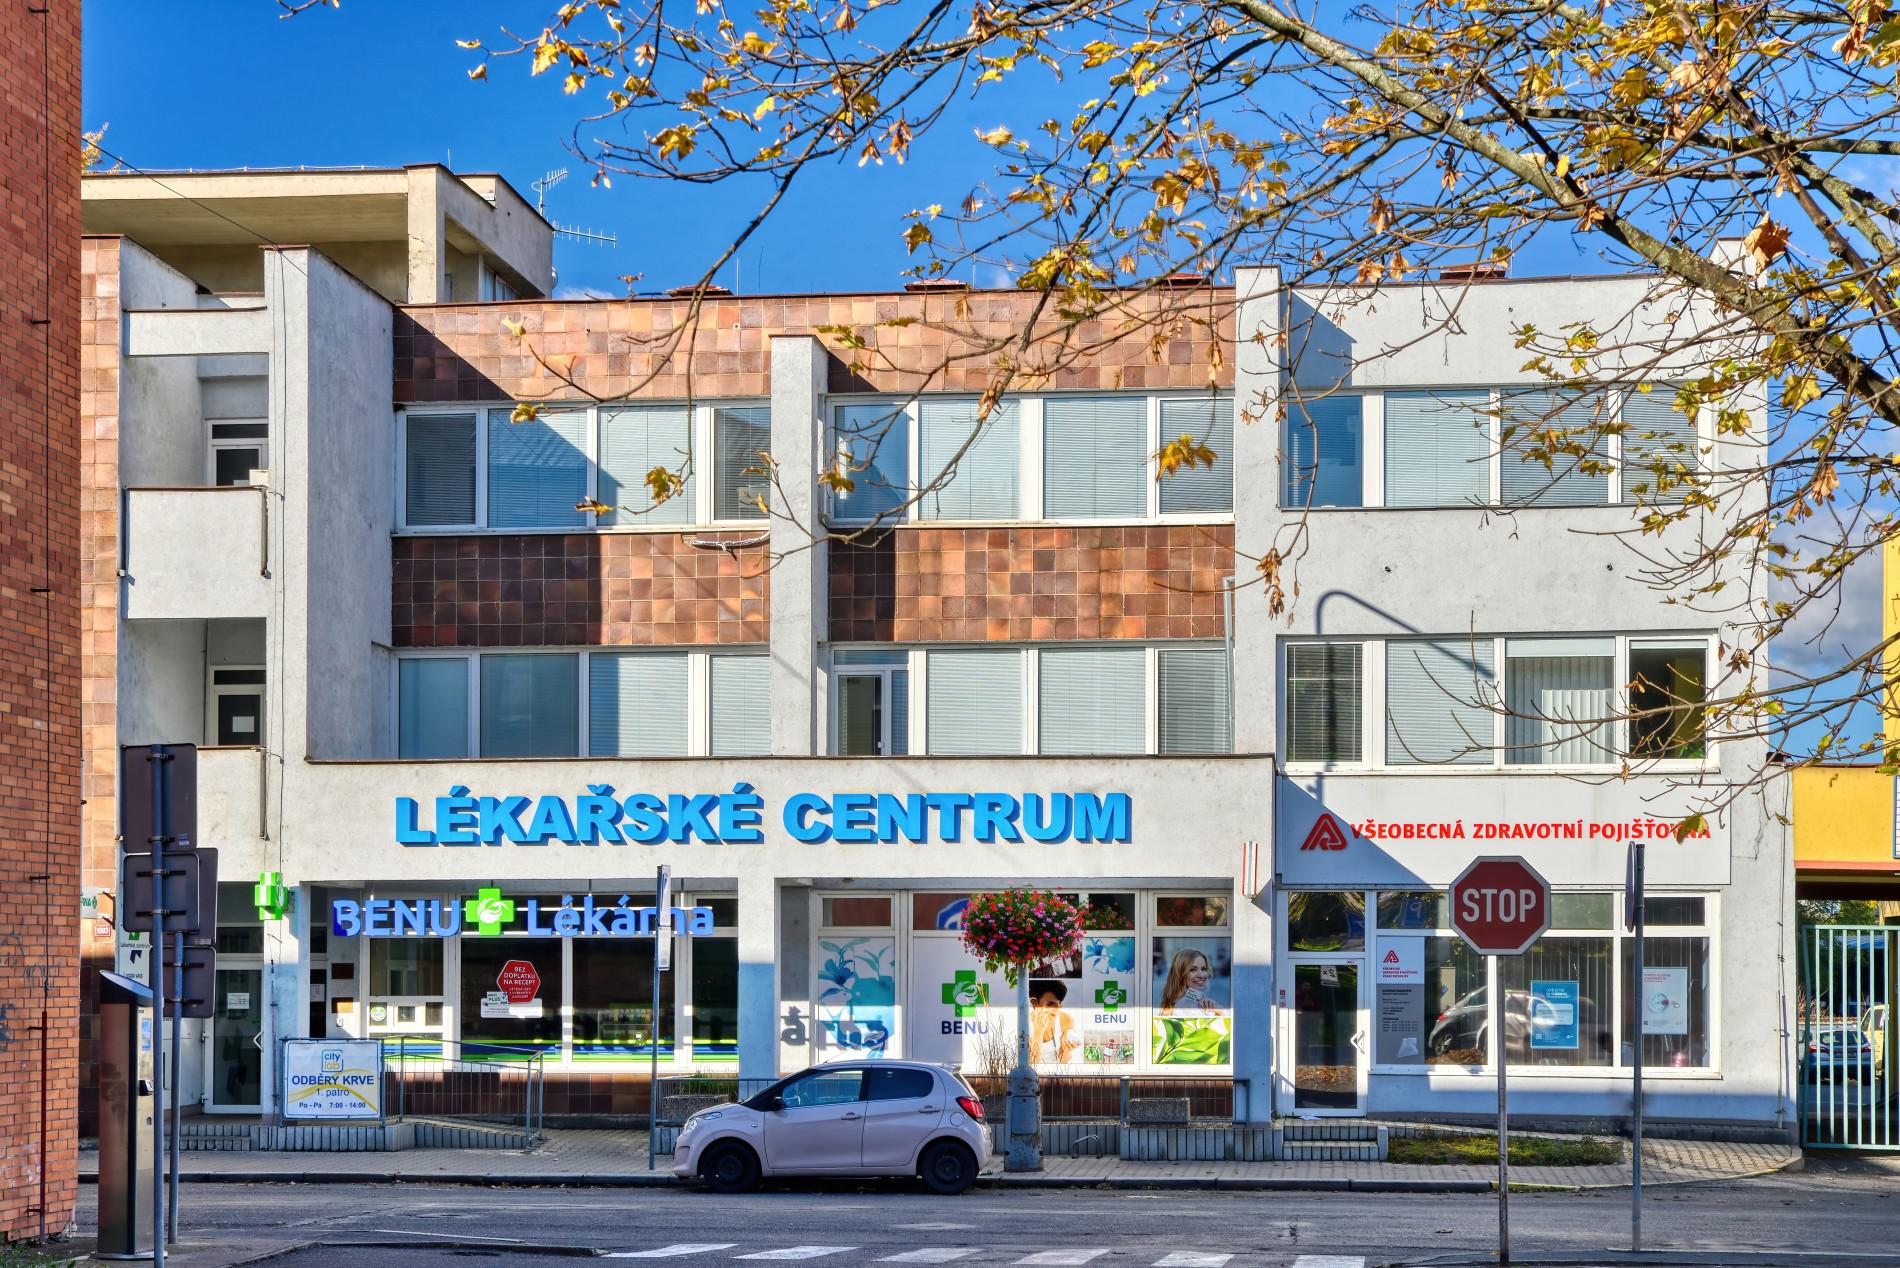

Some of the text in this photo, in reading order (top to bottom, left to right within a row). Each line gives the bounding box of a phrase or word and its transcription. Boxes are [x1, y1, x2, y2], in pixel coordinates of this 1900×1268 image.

[396, 783, 1131, 846] LÉKAŘSKÉ CENTRUM
[1350, 818, 1466, 839] VŠEOBECNÁ
[1473, 819, 1583, 839] ZDRAVOTNÍ
[1462, 888, 1537, 923] STOP
[333, 894, 714, 937] BENU Lékárna
[1094, 1014, 1127, 1024] BENU
[941, 1021, 989, 1035] BENU
[324, 1052, 341, 1061] city
[324, 1062, 340, 1070] lab
[291, 1073, 374, 1086] ODBĚRY KRVE
[317, 1088, 350, 1097] 1. patro
